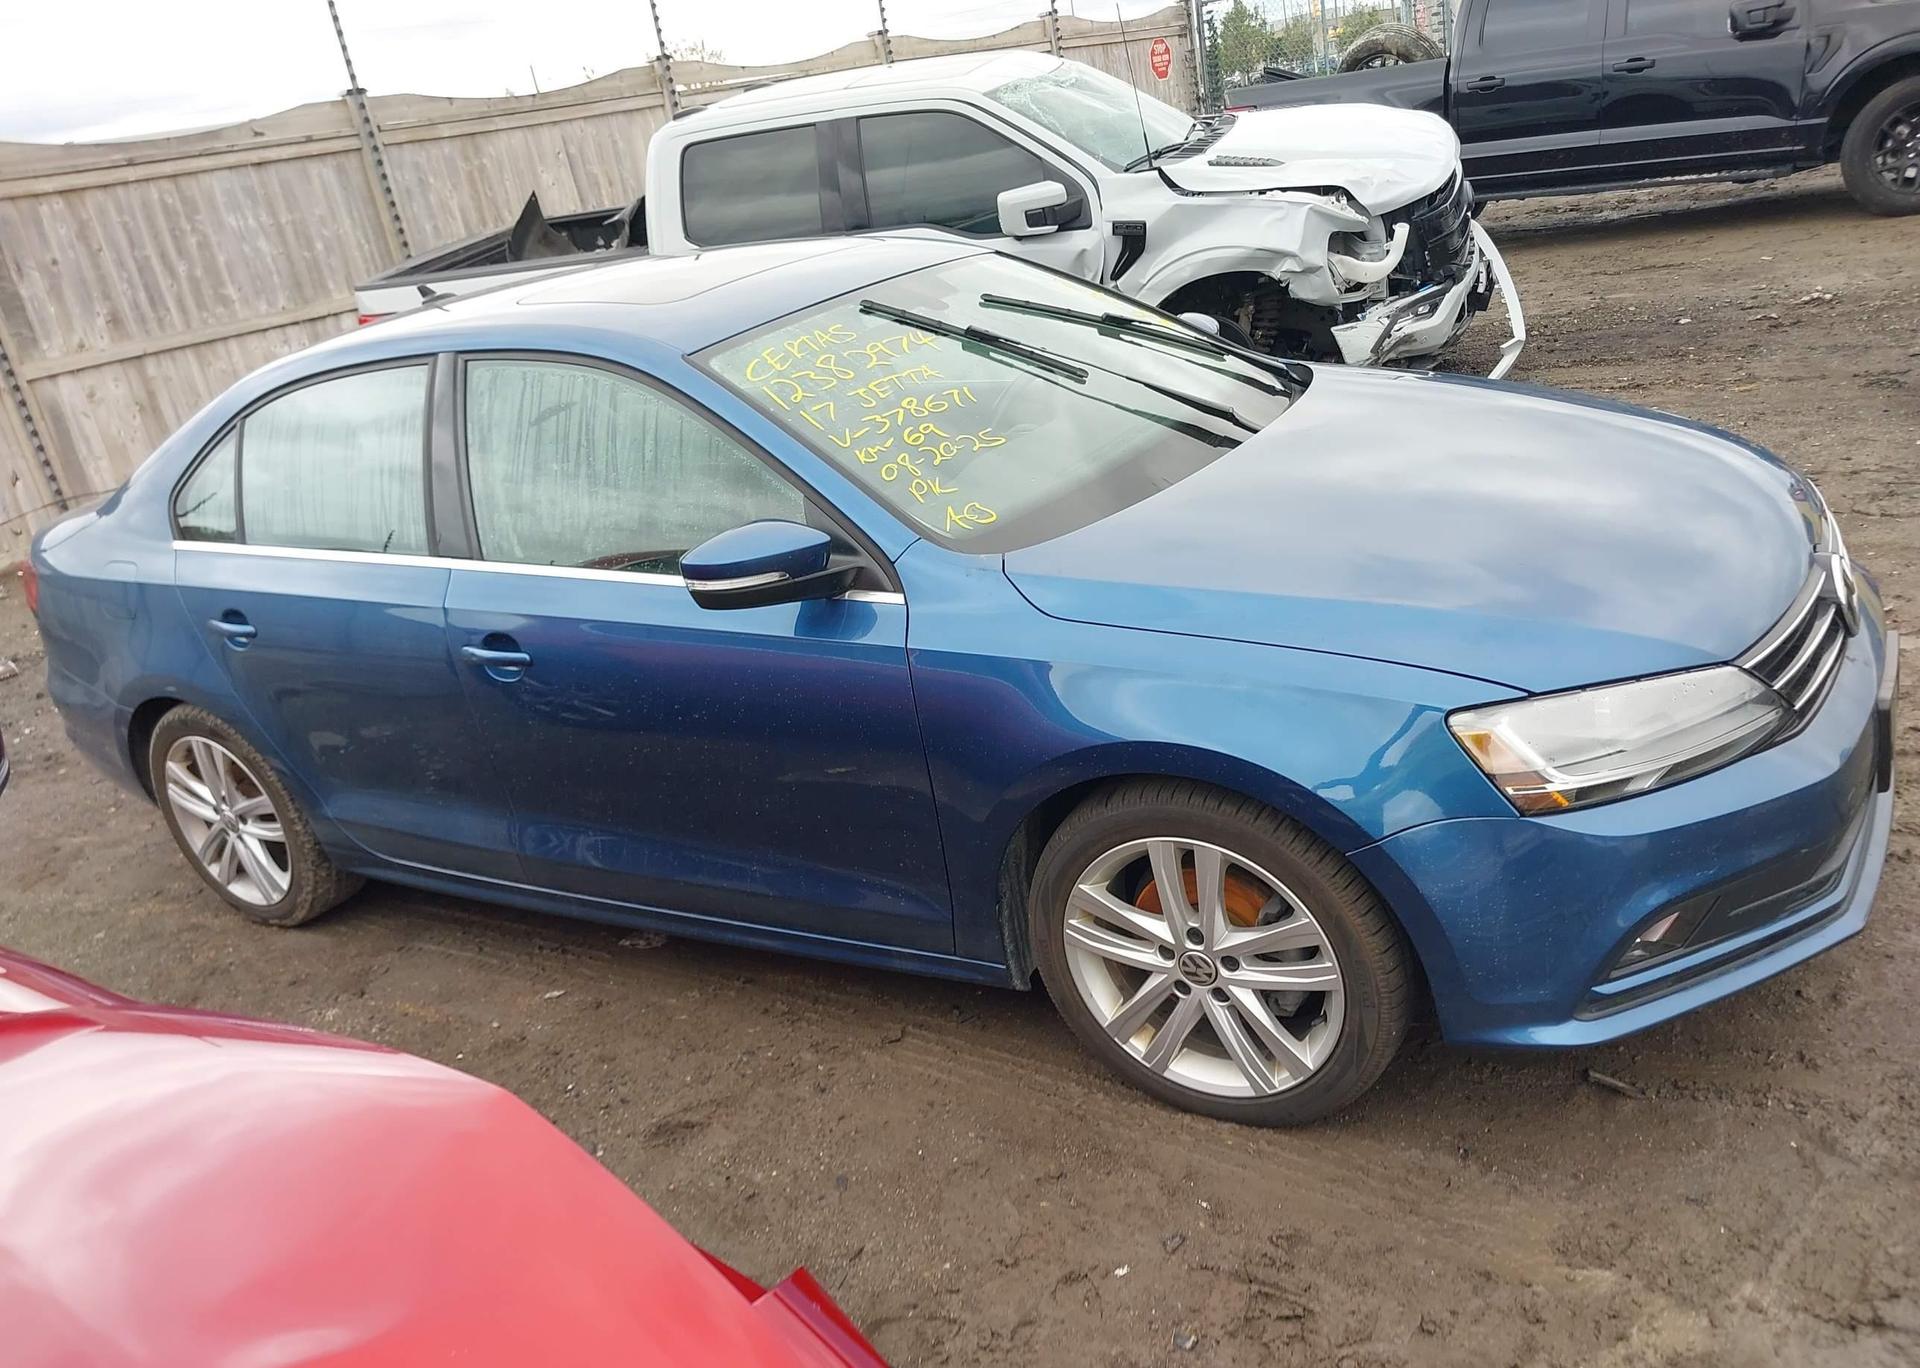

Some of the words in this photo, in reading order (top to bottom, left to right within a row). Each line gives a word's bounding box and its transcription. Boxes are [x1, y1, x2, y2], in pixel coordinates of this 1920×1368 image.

[1153, 43, 1167, 55] STOP
[799, 401, 836, 431] 17
[847, 363, 945, 408] JETTA
[903, 423, 951, 446] 69
